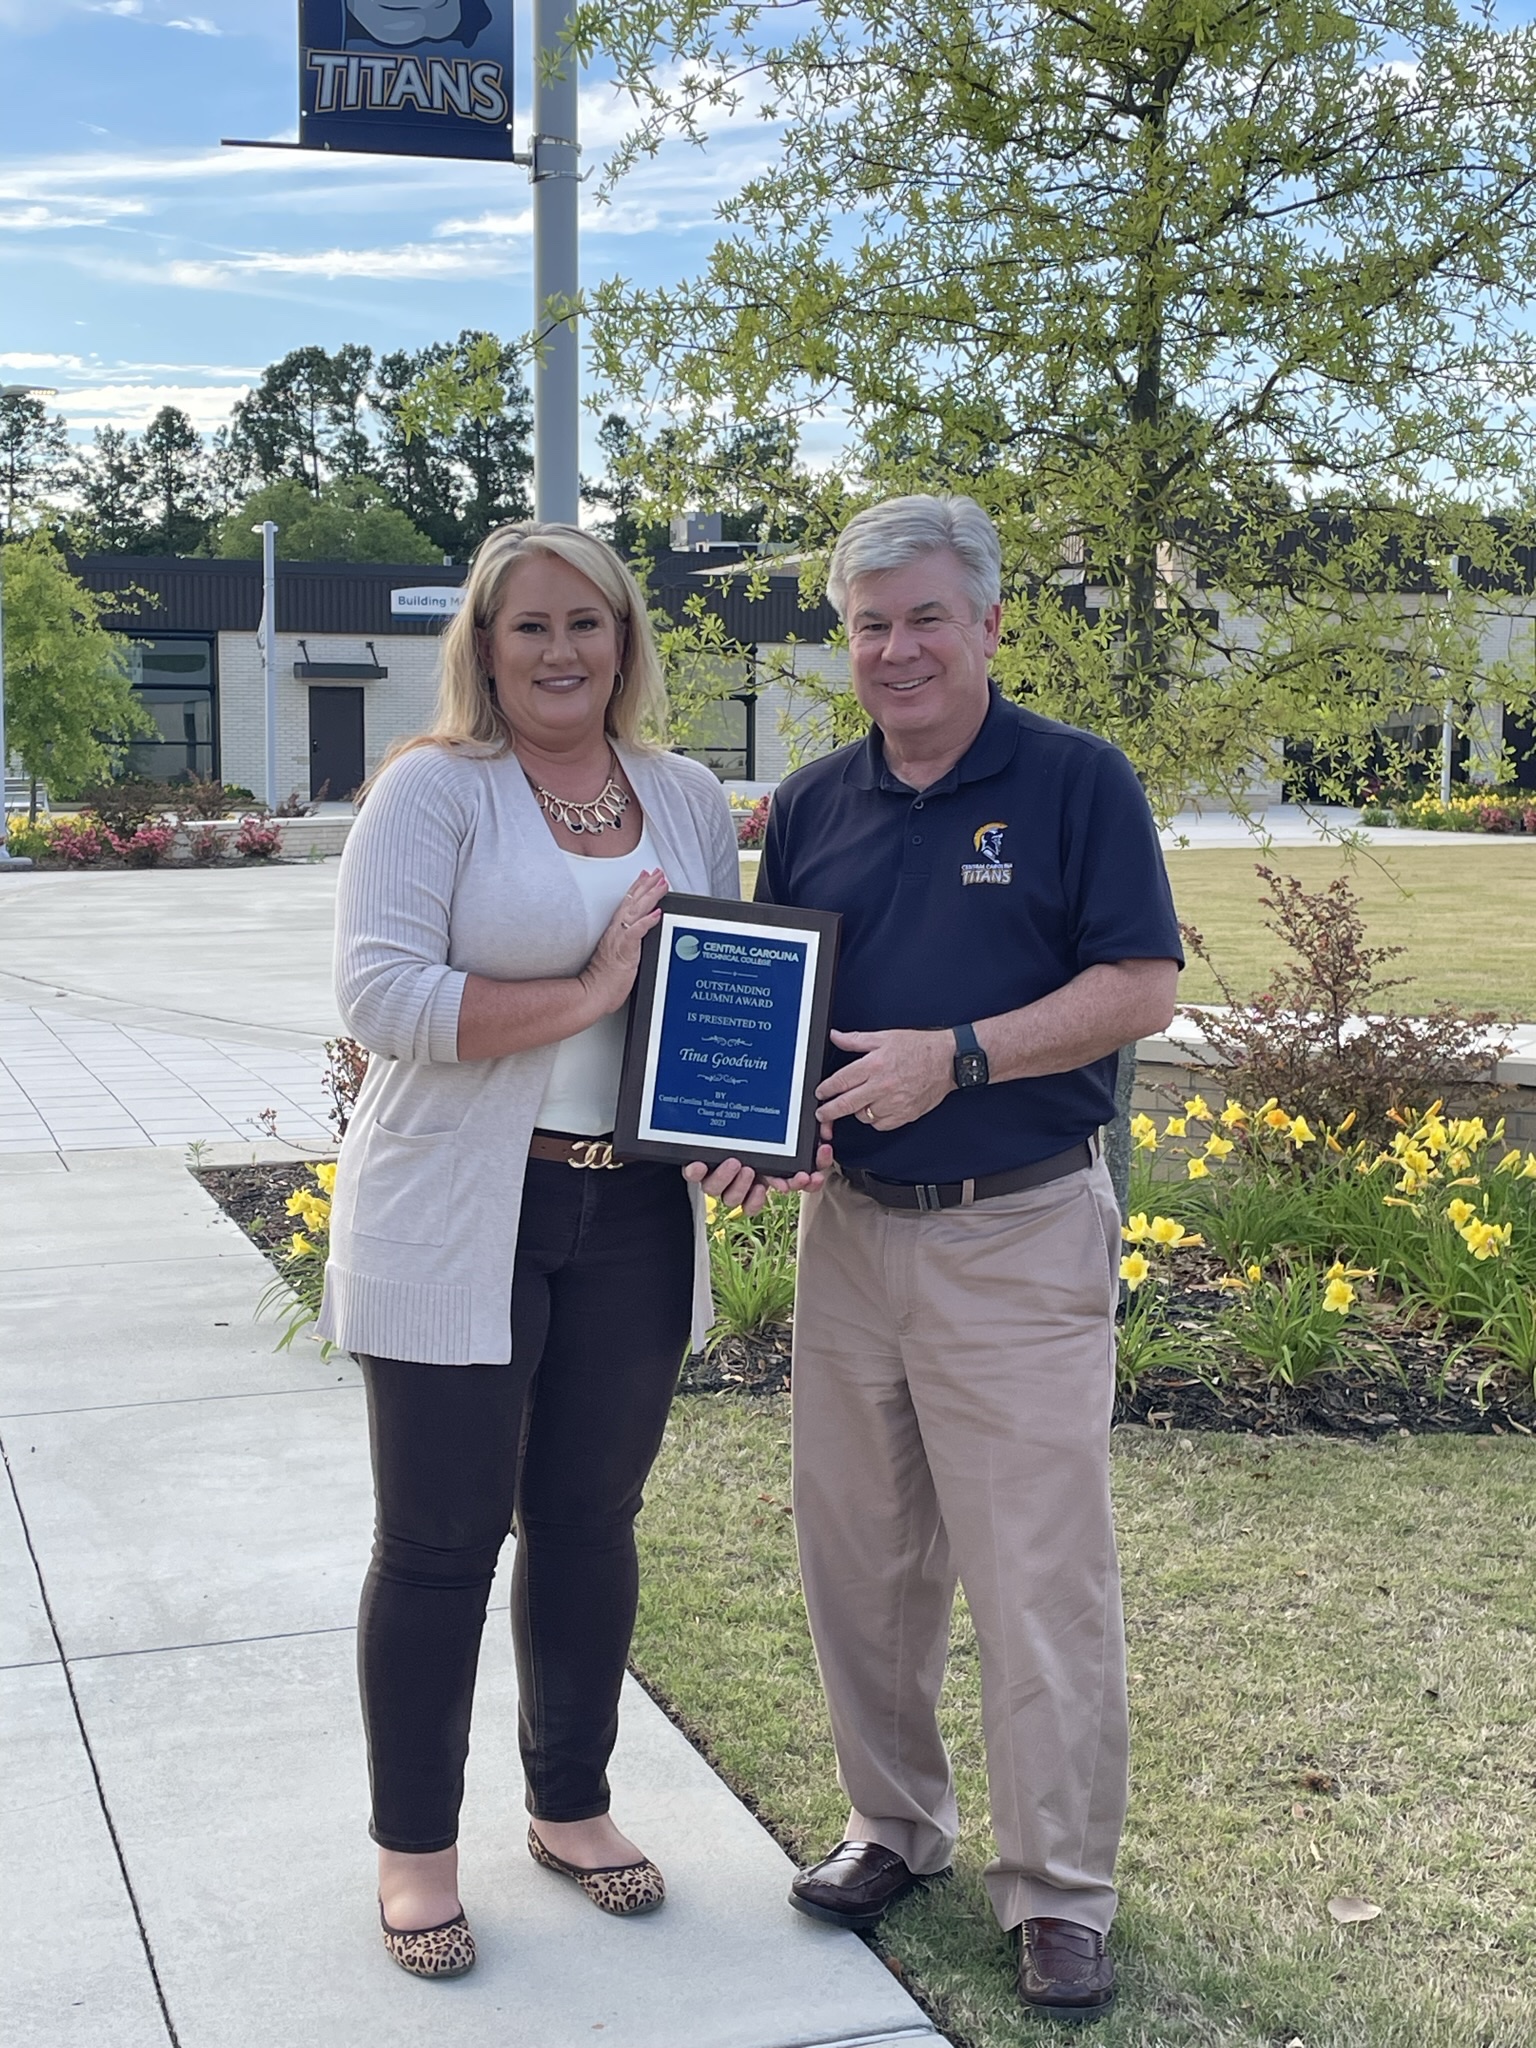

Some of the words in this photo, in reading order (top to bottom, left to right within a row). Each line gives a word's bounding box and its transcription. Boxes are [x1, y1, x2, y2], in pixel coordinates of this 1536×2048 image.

[307, 50, 508, 124] TITANS
[398, 596, 447, 608] Building
[961, 870, 1012, 886] TITANS
[702, 952, 739, 962] TECHNICAL
[741, 956, 771, 966] COLLEGE
[703, 942, 747, 955] CENTRAL
[749, 947, 799, 962] CAROLINA
[696, 980, 771, 996] OUTSTANDING
[691, 992, 733, 1003] ALUMNI
[736, 998, 773, 1008] AWARD
[687, 1012, 697, 1022] IS
[699, 1014, 756, 1028] PRESENTED
[758, 1021, 772, 1031] TO
[680, 1048, 708, 1062] Tina
[712, 1053, 768, 1070] Goodwin
[659, 1094, 678, 1103] Central
[680, 1096, 702, 1106] Carolina
[715, 1091, 727, 1099] BY
[698, 1108, 715, 1116] Class
